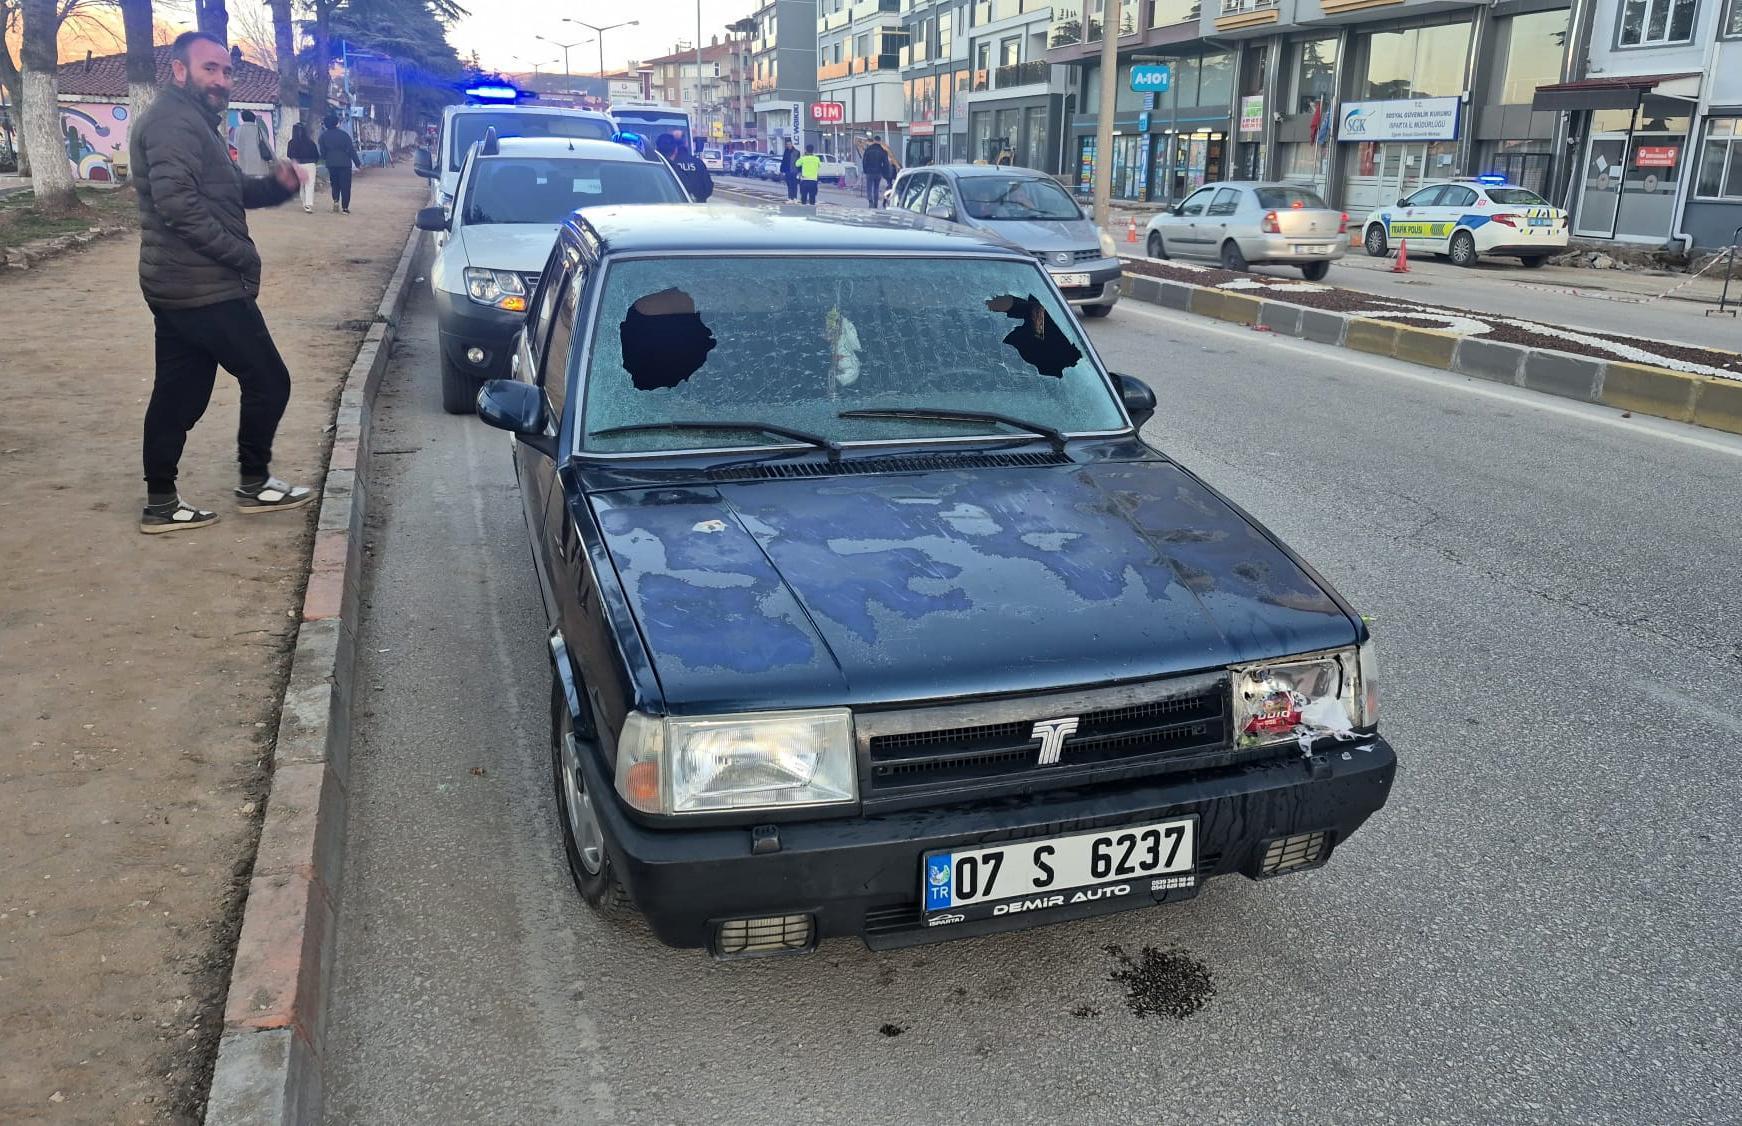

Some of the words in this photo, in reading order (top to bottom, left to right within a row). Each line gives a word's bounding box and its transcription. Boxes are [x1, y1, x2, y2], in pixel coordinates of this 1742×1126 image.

[1348, 118, 1367, 132] SGK
[955, 851, 1005, 900] 07
[1033, 845, 1056, 888] S
[1091, 826, 1186, 879] 6237
[931, 885, 949, 901] TR
[1070, 884, 1131, 904] AUTO
